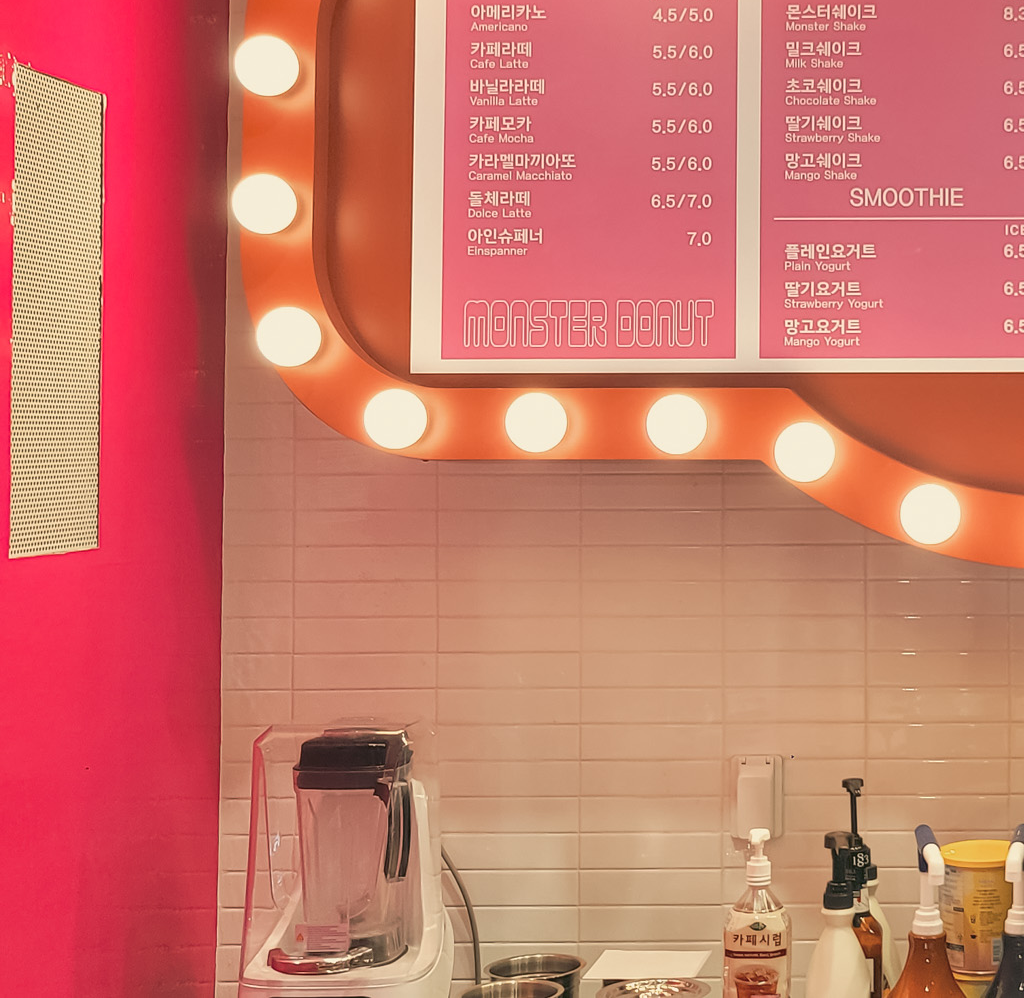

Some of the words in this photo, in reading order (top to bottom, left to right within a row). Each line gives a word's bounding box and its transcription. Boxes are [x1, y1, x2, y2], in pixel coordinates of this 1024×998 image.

[471, 5, 546, 20] 아메리카노
[653, 8, 713, 22] 4.5/5.0
[786, 4, 877, 19] 몬스터쉐이크
[471, 22, 527, 31] Americano
[786, 22, 829, 31] Monster
[834, 21, 866, 30] Shake
[471, 42, 531, 57] 카페라떼
[653, 45, 712, 59] 5.5/6.0
[786, 41, 861, 57] 밀크쉐이크
[470, 59, 495, 68] Cafe
[500, 59, 528, 68] Latte
[786, 59, 806, 68] Milk
[811, 59, 843, 68] Shake
[470, 79, 544, 94] 바닐라라떼
[653, 82, 712, 96] 5.5/6.0
[786, 78, 862, 94] 초코쉐이크
[470, 96, 504, 105] Vanilla
[509, 96, 538, 105] Latte
[786, 96, 840, 105] Chocolate
[844, 96, 876, 105] Shake
[470, 116, 531, 132] 카페모카
[652, 119, 712, 134] 5.5/6.0
[786, 116, 862, 131] 딸기쉐이크
[469, 134, 494, 143] Cafe
[499, 133, 533, 143] Mocha
[785, 133, 844, 144] Strawberry
[848, 133, 880, 142] Shake
[469, 154, 576, 169] 카라멜마끼아또
[652, 157, 711, 171] 5.5/6.0
[786, 153, 862, 169] 망고쉐이크
[469, 171, 511, 180] Caramel
[516, 171, 572, 180] Macchiato
[785, 170, 820, 181] Mango
[824, 170, 857, 179] Shake
[468, 191, 530, 207] 돌체라떼
[652, 194, 711, 208] 6.5/7.0
[850, 188, 963, 206] SMOOTHIE
[468, 208, 498, 218] Dolce
[503, 208, 531, 217] Latte
[468, 228, 542, 244] 아인슈페너
[687, 232, 711, 246] 7.0
[468, 246, 528, 257] Einspanner
[785, 244, 876, 260] 플레인요거트
[785, 261, 810, 270] Plain
[815, 261, 850, 272] Yogurt
[785, 282, 861, 297] 딸기요거트
[785, 299, 843, 310] Strawberry
[848, 299, 883, 310] Yogurt
[464, 300, 607, 347] MONSTER
[616, 300, 714, 347] DONUT
[785, 319, 861, 335] 망고요거트
[785, 337, 819, 347] Mango
[824, 337, 860, 347] Yogurt
[732, 932, 783, 947] 카페시럽
